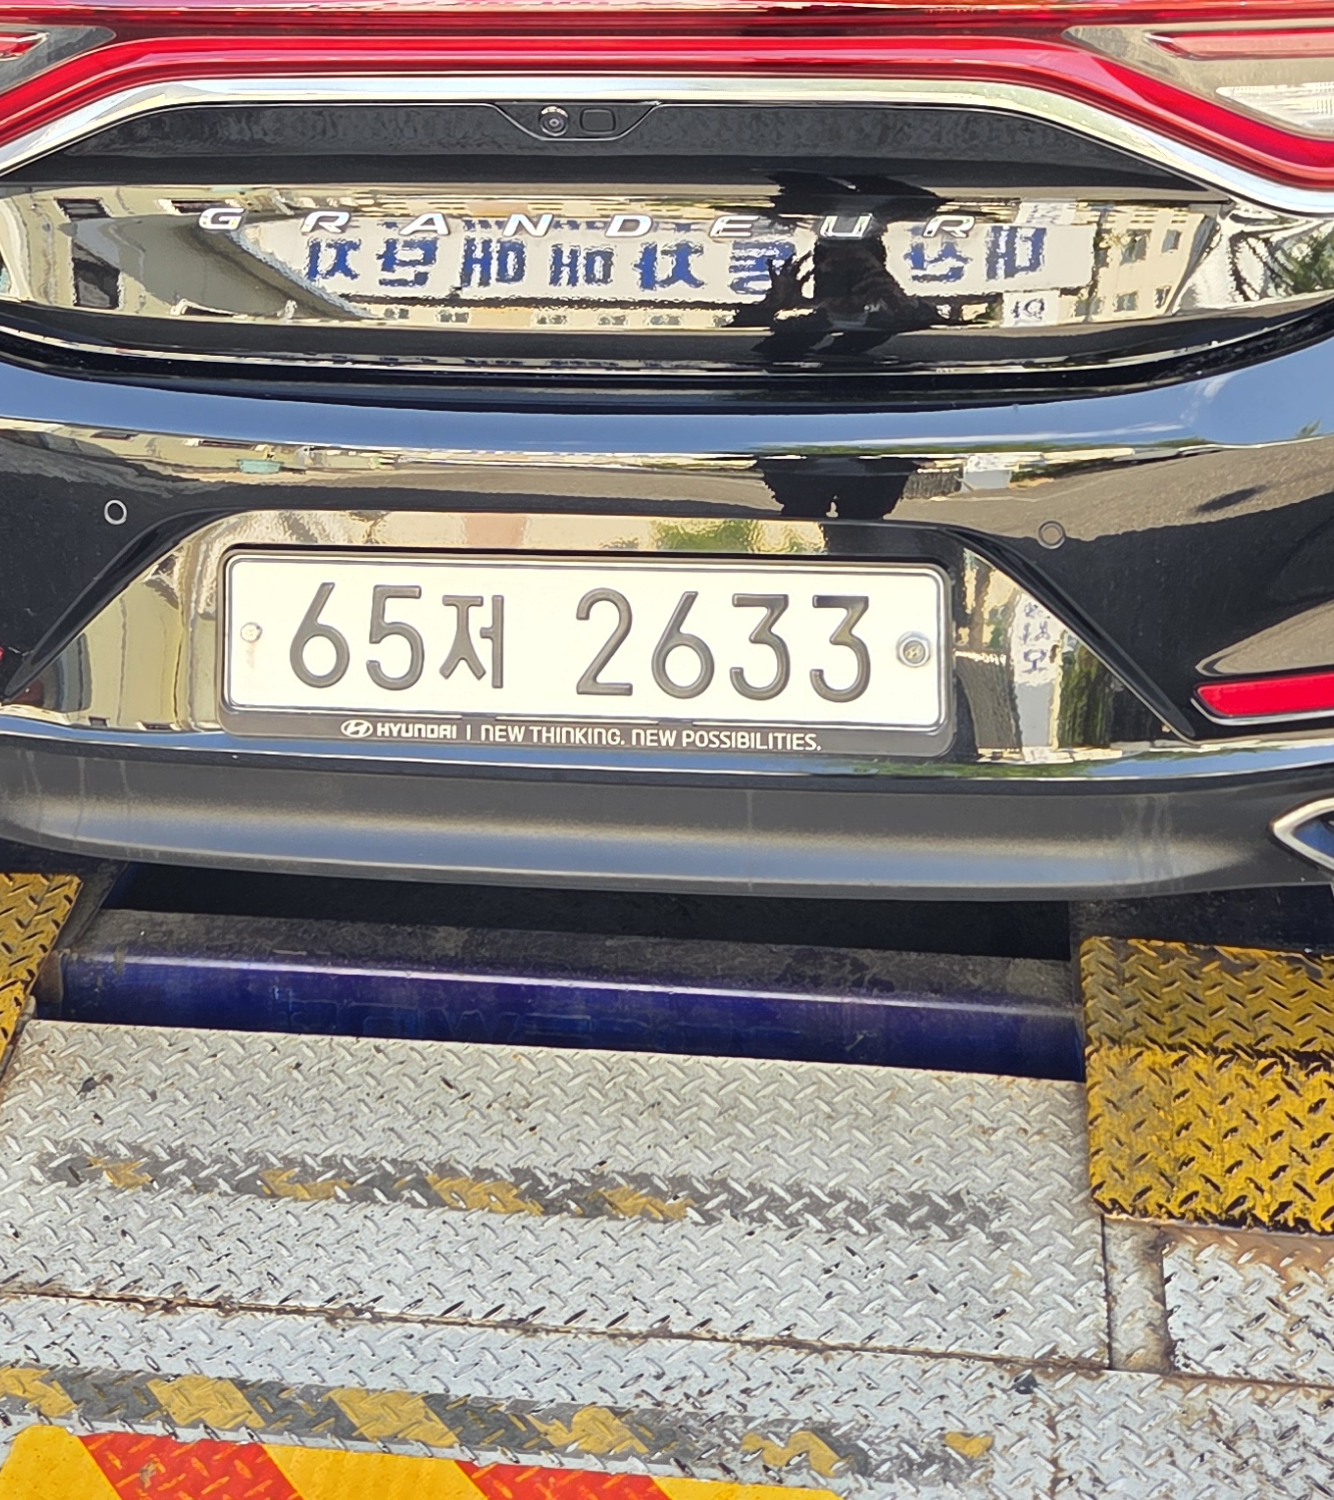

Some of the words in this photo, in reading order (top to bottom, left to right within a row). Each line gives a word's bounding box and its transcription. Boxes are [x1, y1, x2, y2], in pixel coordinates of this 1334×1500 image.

[198, 207, 976, 240] GRANDEUR
[289, 580, 505, 690] 65저
[575, 586, 870, 703] 2633
[376, 723, 457, 740] HYUNDAI
[481, 725, 525, 742] NEW
[631, 728, 679, 747] NEW
[681, 730, 822, 751] POSSIBILITIES.
